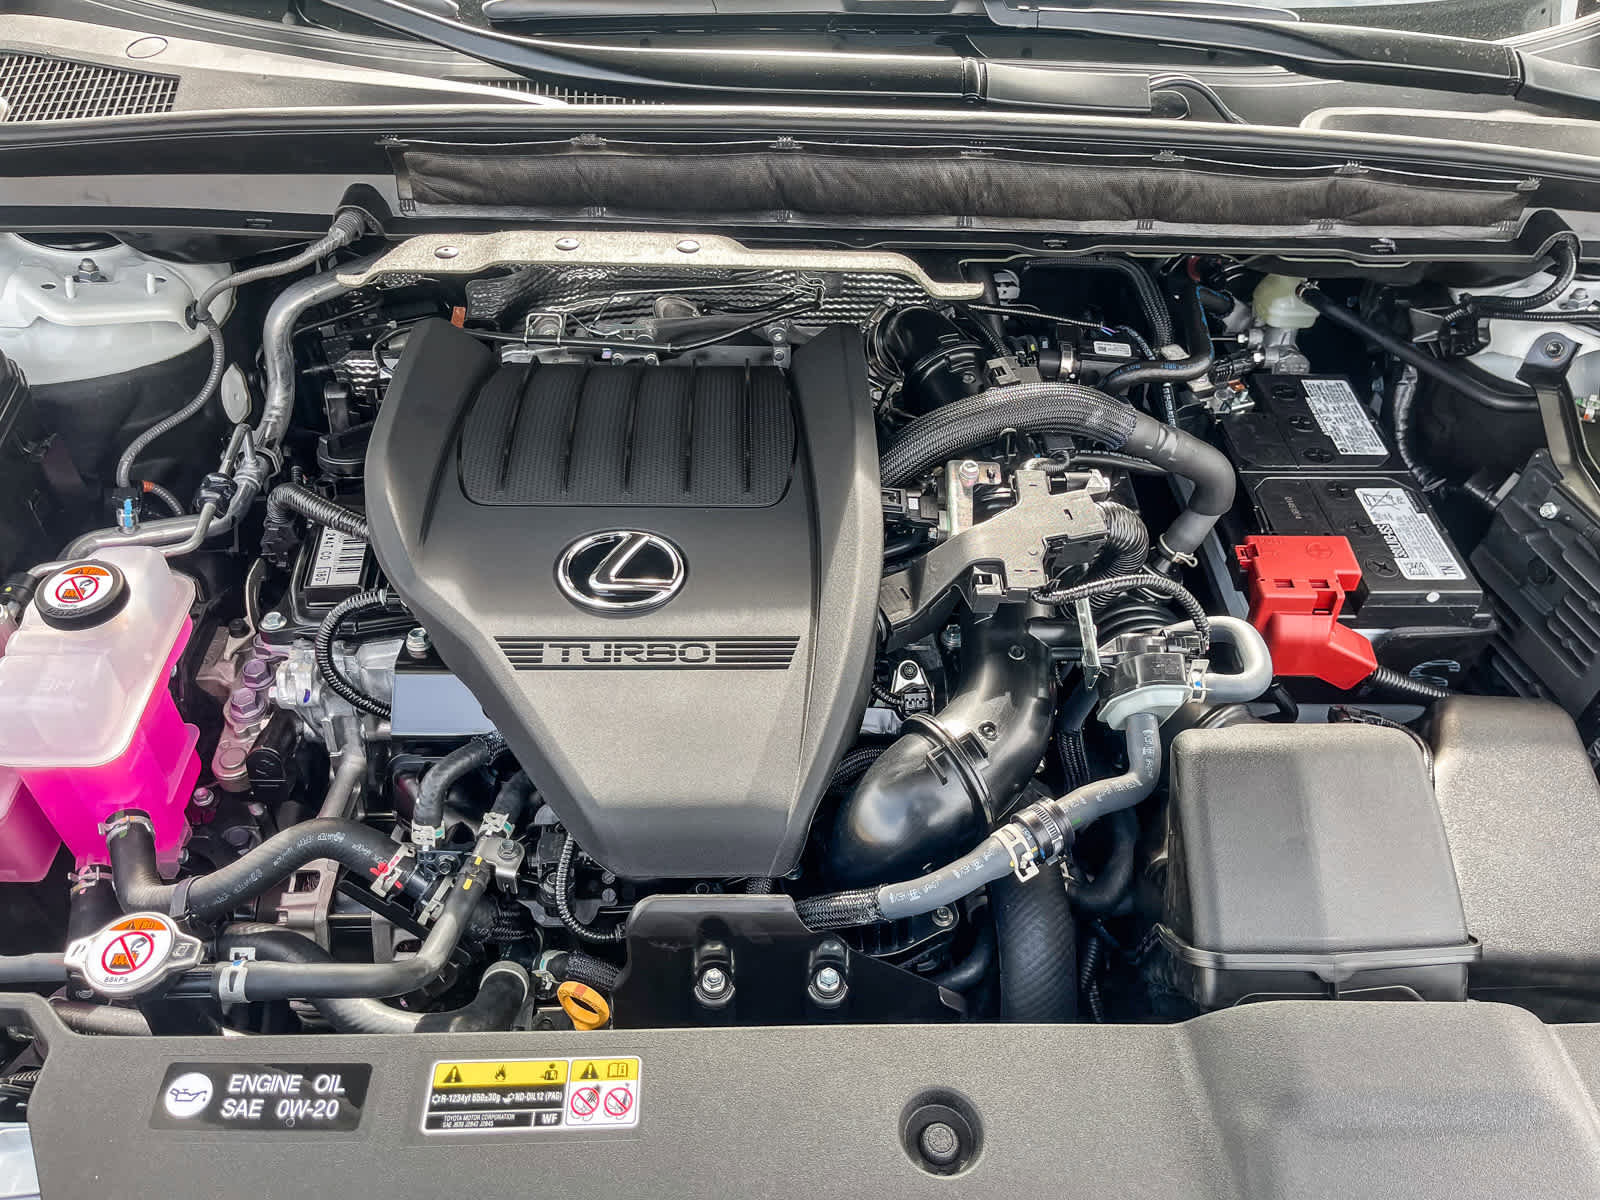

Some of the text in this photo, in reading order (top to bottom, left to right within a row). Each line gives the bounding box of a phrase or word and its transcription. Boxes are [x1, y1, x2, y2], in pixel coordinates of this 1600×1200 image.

[548, 642, 711, 663] TURBO
[227, 1073, 346, 1094] ENGINE OIL
[219, 1098, 339, 1119] SAE 0W-20
[541, 1112, 558, 1124] WF
